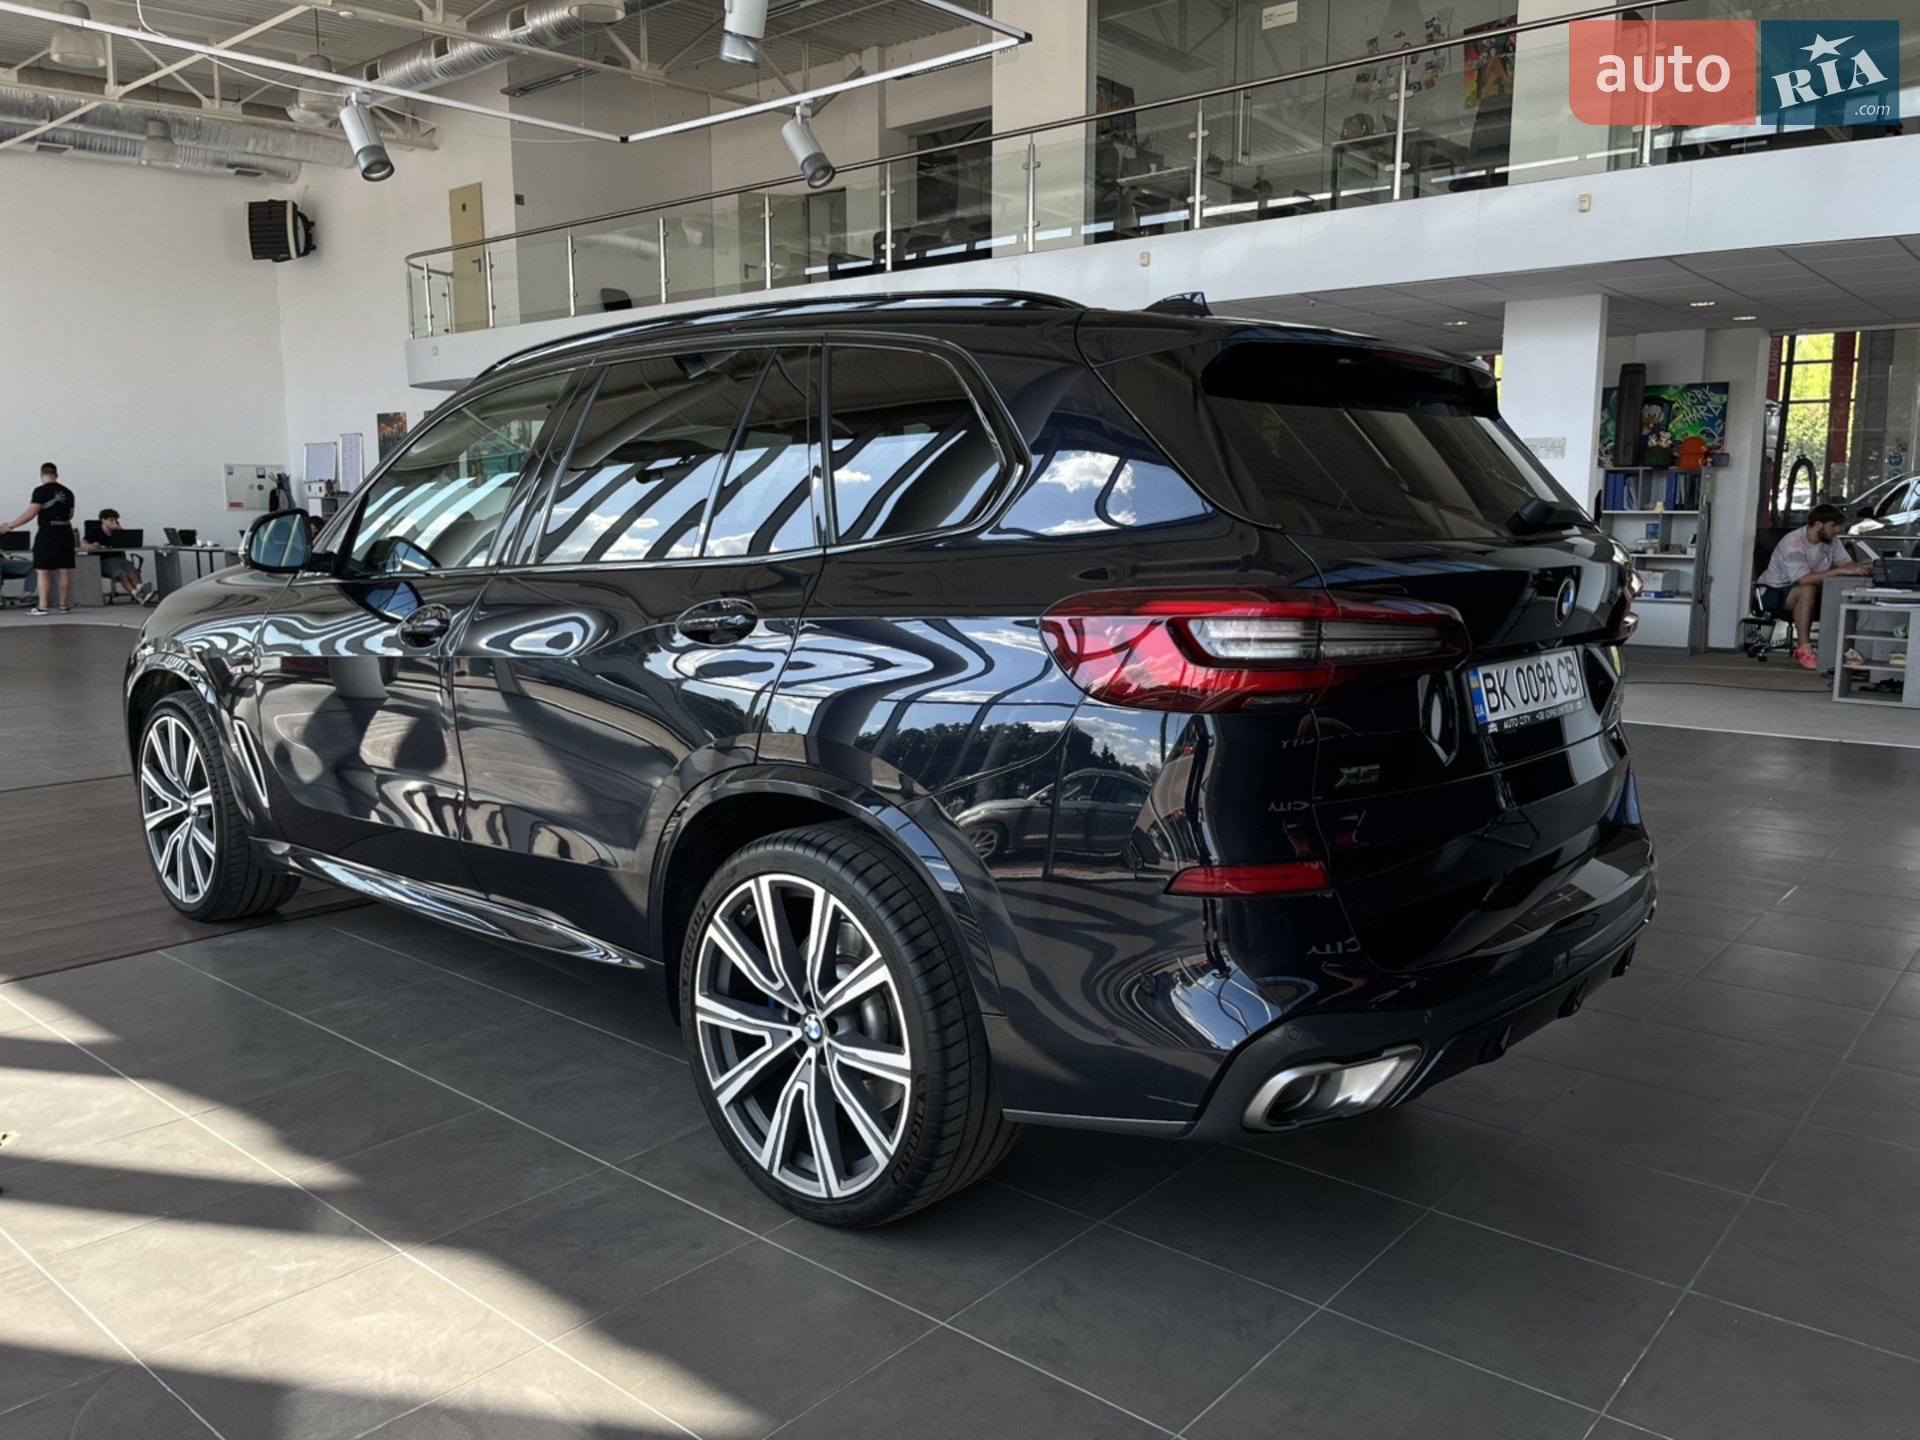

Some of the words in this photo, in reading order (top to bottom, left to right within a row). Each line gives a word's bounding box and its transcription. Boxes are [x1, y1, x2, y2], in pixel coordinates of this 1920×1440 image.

[1482, 668, 1516, 714] BK
[1515, 660, 1557, 705] 0098
[1557, 655, 1579, 696] CB
[1474, 704, 1485, 717] UA
[1334, 763, 1380, 787] X5
[892, 1100, 925, 1183] MICHELIN
